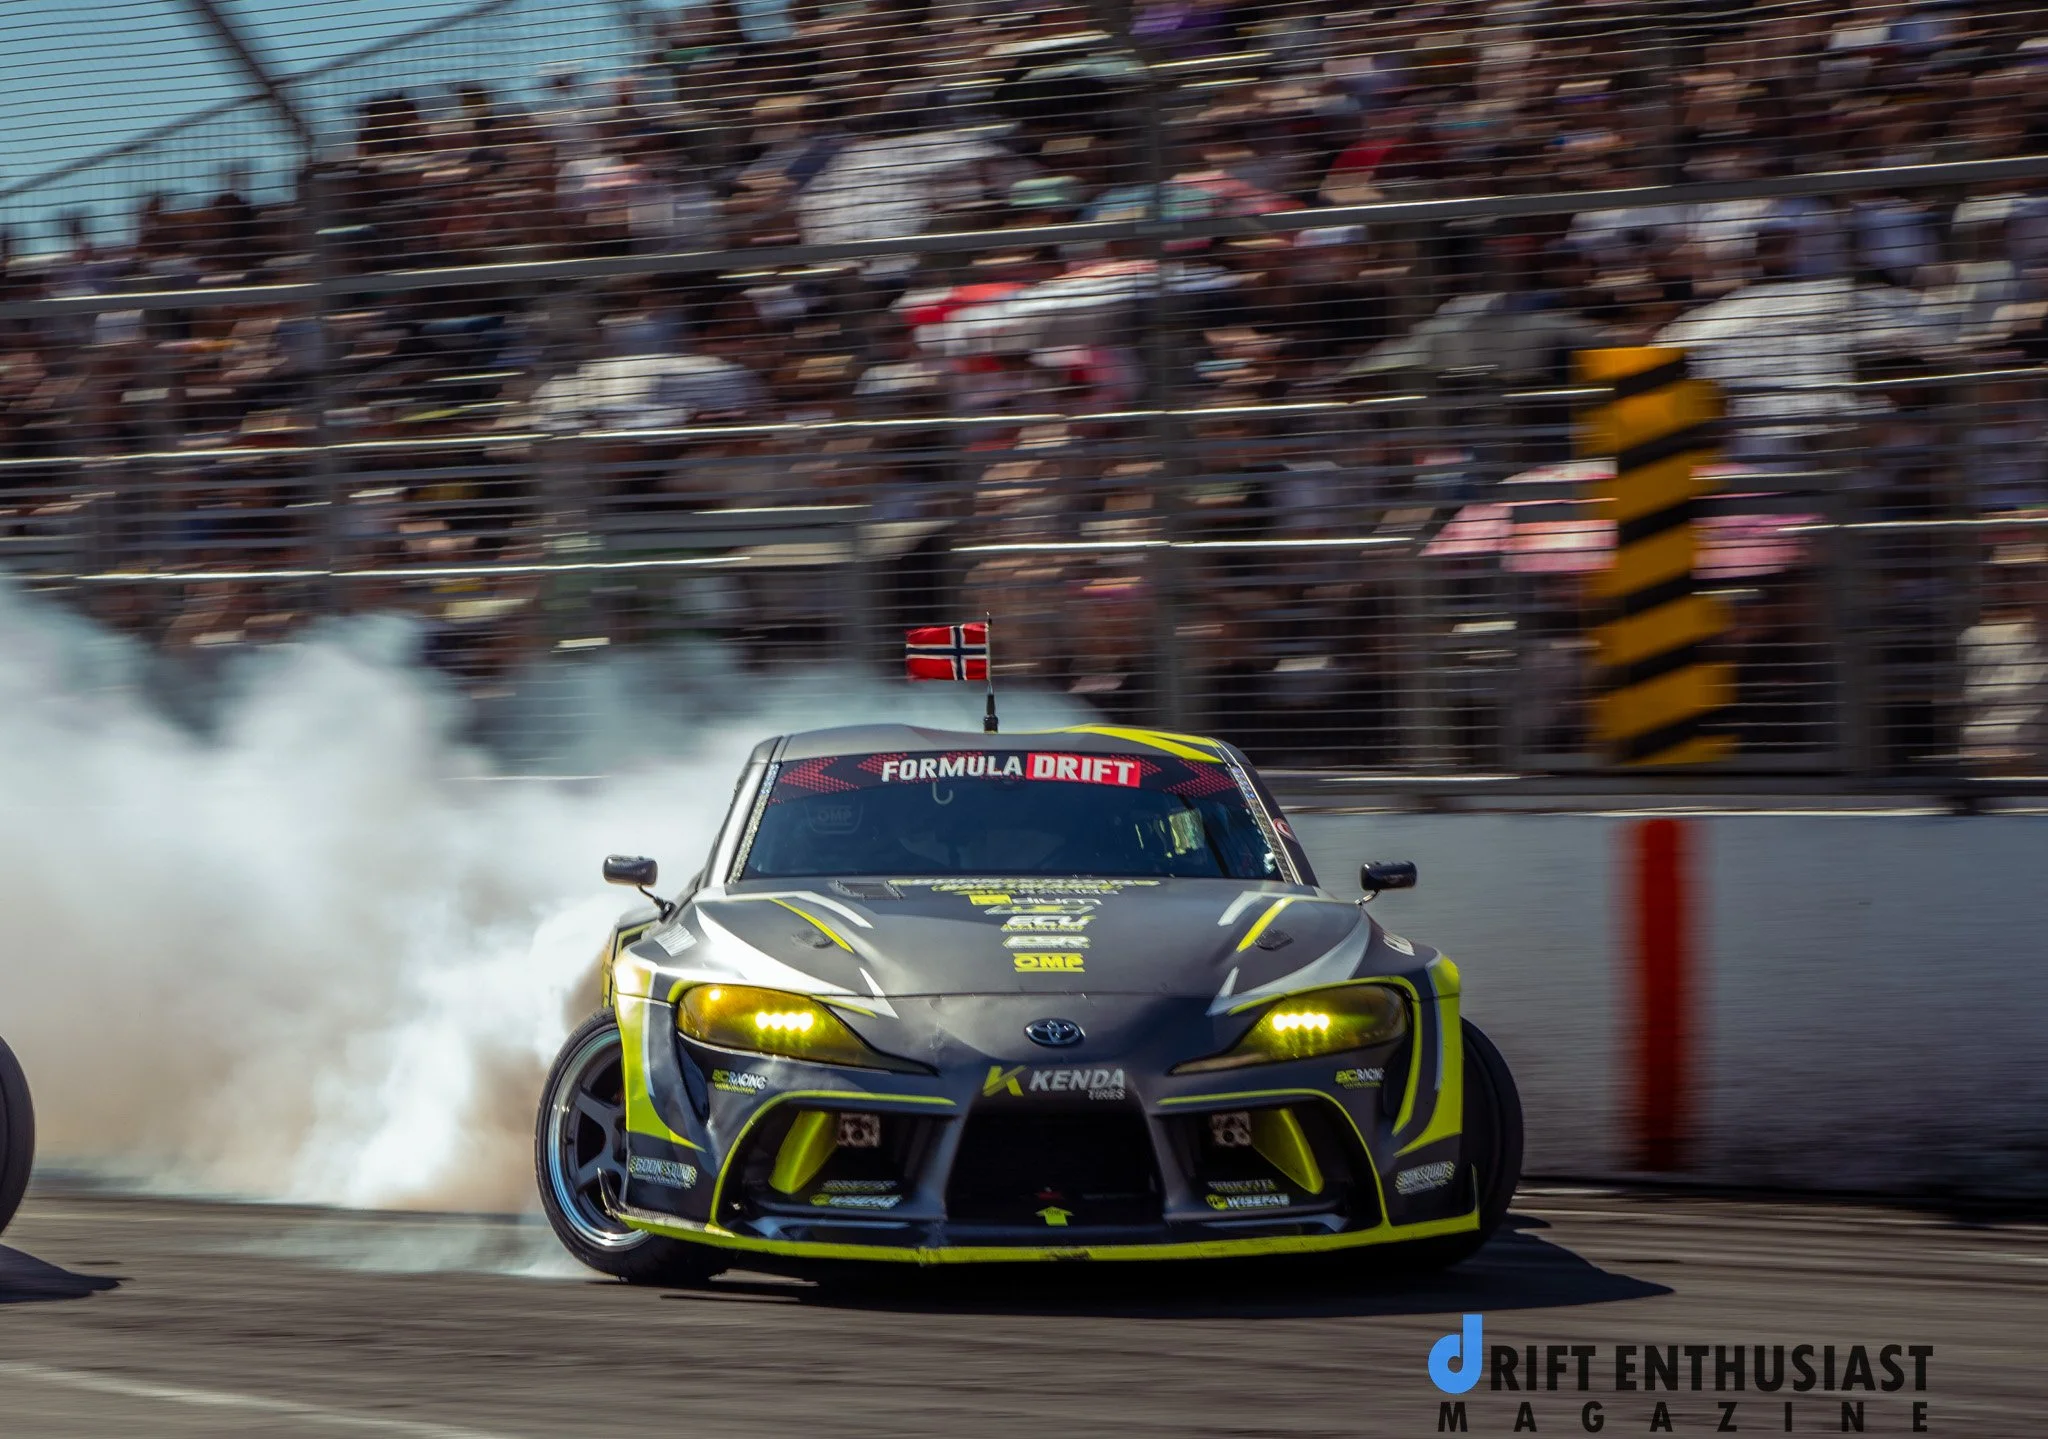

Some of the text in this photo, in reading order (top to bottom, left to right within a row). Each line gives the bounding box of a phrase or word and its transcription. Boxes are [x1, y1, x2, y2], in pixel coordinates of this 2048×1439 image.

[881, 755, 1135, 785] FORMULA DRIFT
[1013, 954, 1084, 970] OMP
[728, 1071, 767, 1090] RACING
[1028, 1068, 1126, 1092] KENDA
[1087, 1089, 1126, 1100] TIRES
